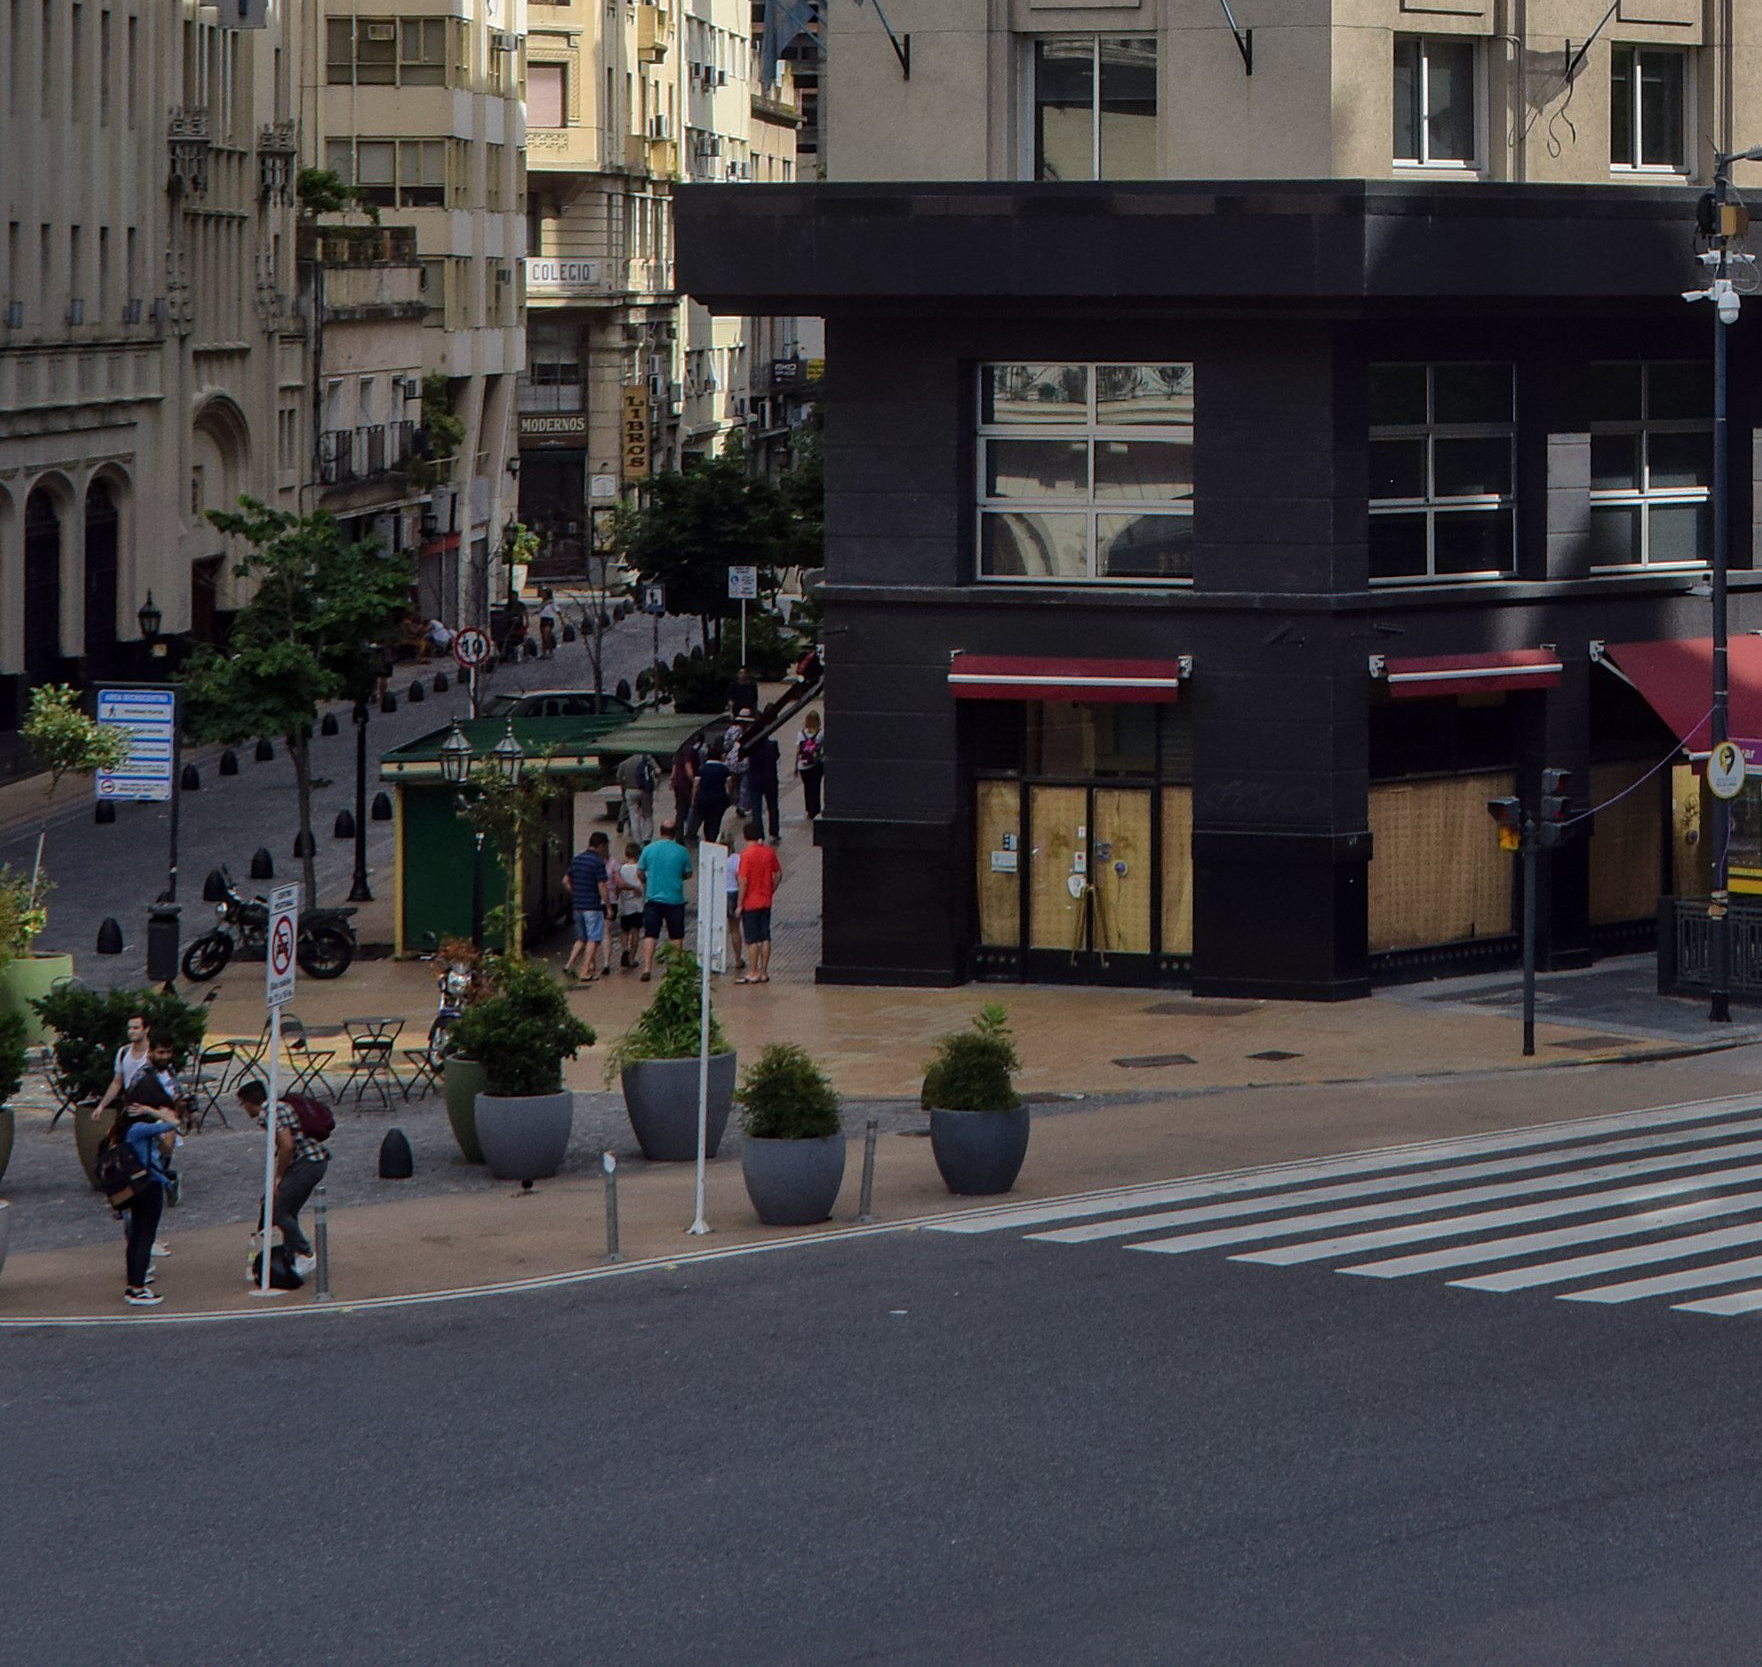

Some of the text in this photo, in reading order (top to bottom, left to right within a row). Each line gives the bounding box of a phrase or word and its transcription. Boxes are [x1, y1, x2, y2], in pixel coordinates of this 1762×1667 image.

[532, 264, 590, 281] COLEGIO
[521, 417, 585, 432] MODERNOS
[625, 395, 645, 467] LIBROS
[462, 639, 483, 654] 10
